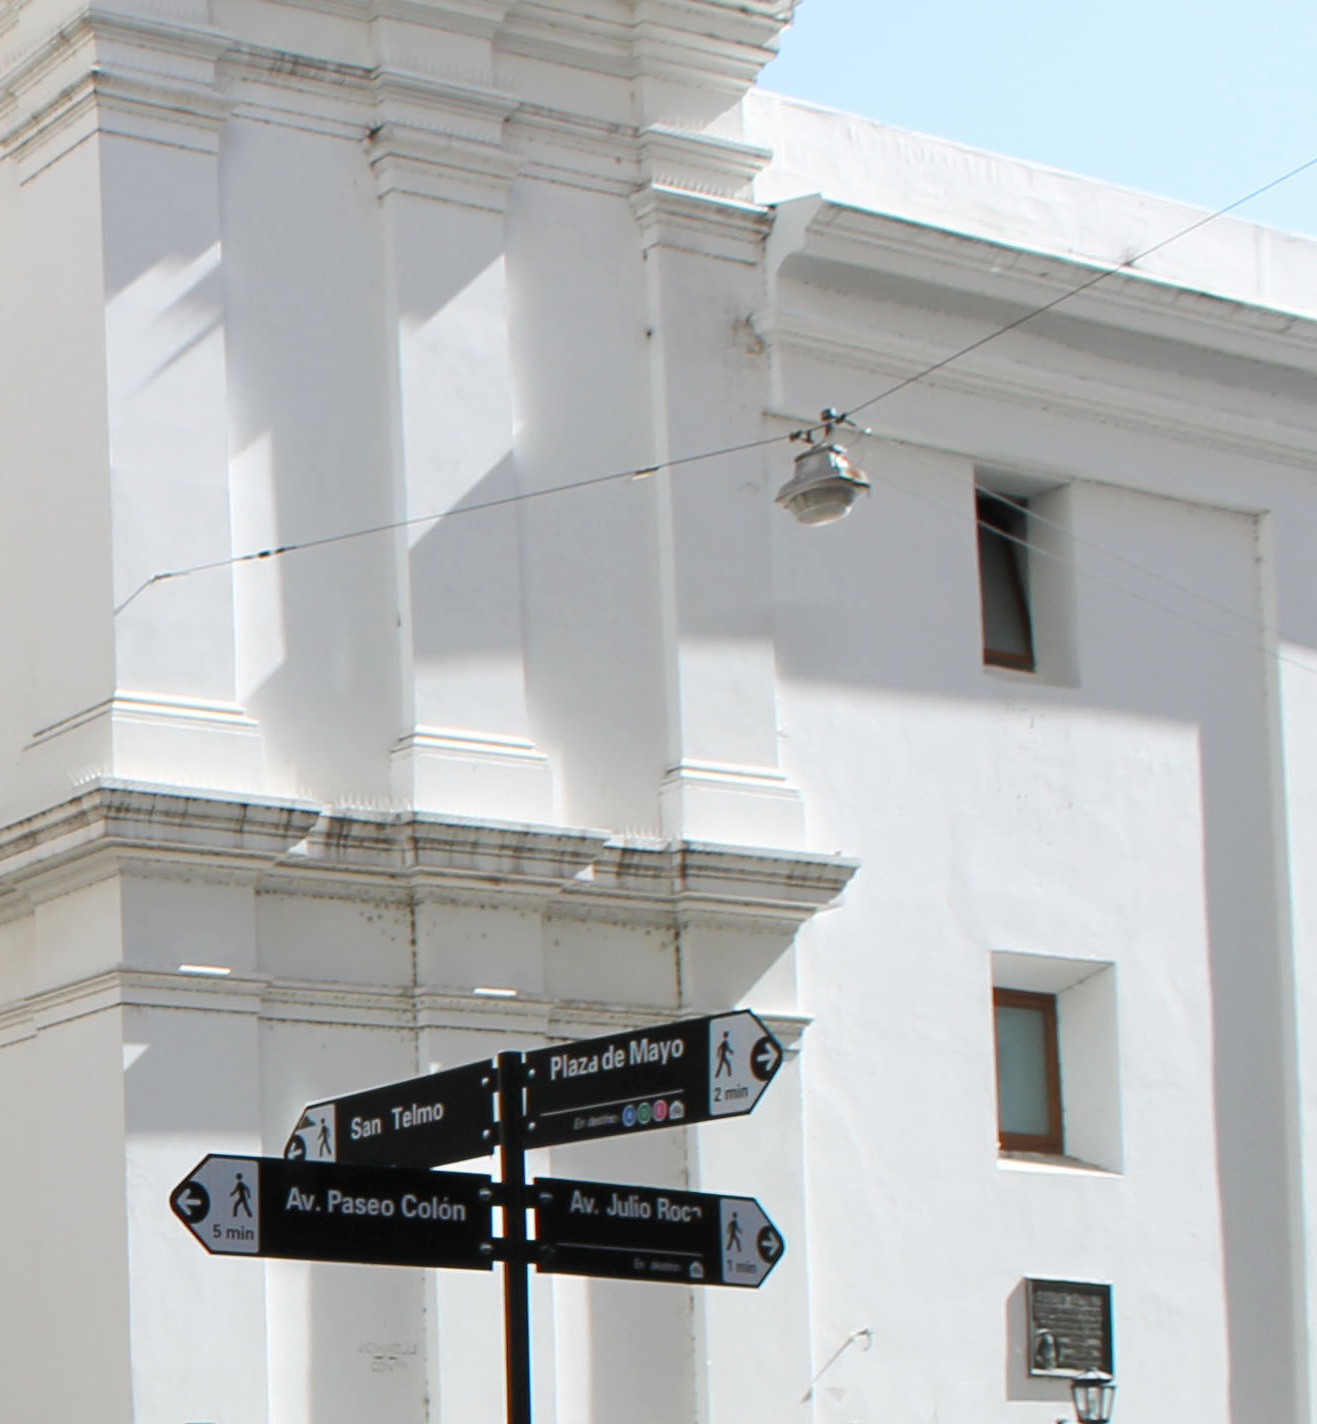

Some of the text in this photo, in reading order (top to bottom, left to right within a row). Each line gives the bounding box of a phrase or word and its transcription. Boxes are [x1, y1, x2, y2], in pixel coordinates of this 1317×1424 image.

[550, 1037, 685, 1081] Plaza de Mayo
[713, 1084, 749, 1102] 2 min
[350, 1102, 444, 1140] San Telmo
[285, 1186, 466, 1221] Av. Paseo Colón
[569, 1189, 598, 1215] Av.
[606, 1193, 651, 1219] Julio
[212, 1224, 254, 1241] 5 min
